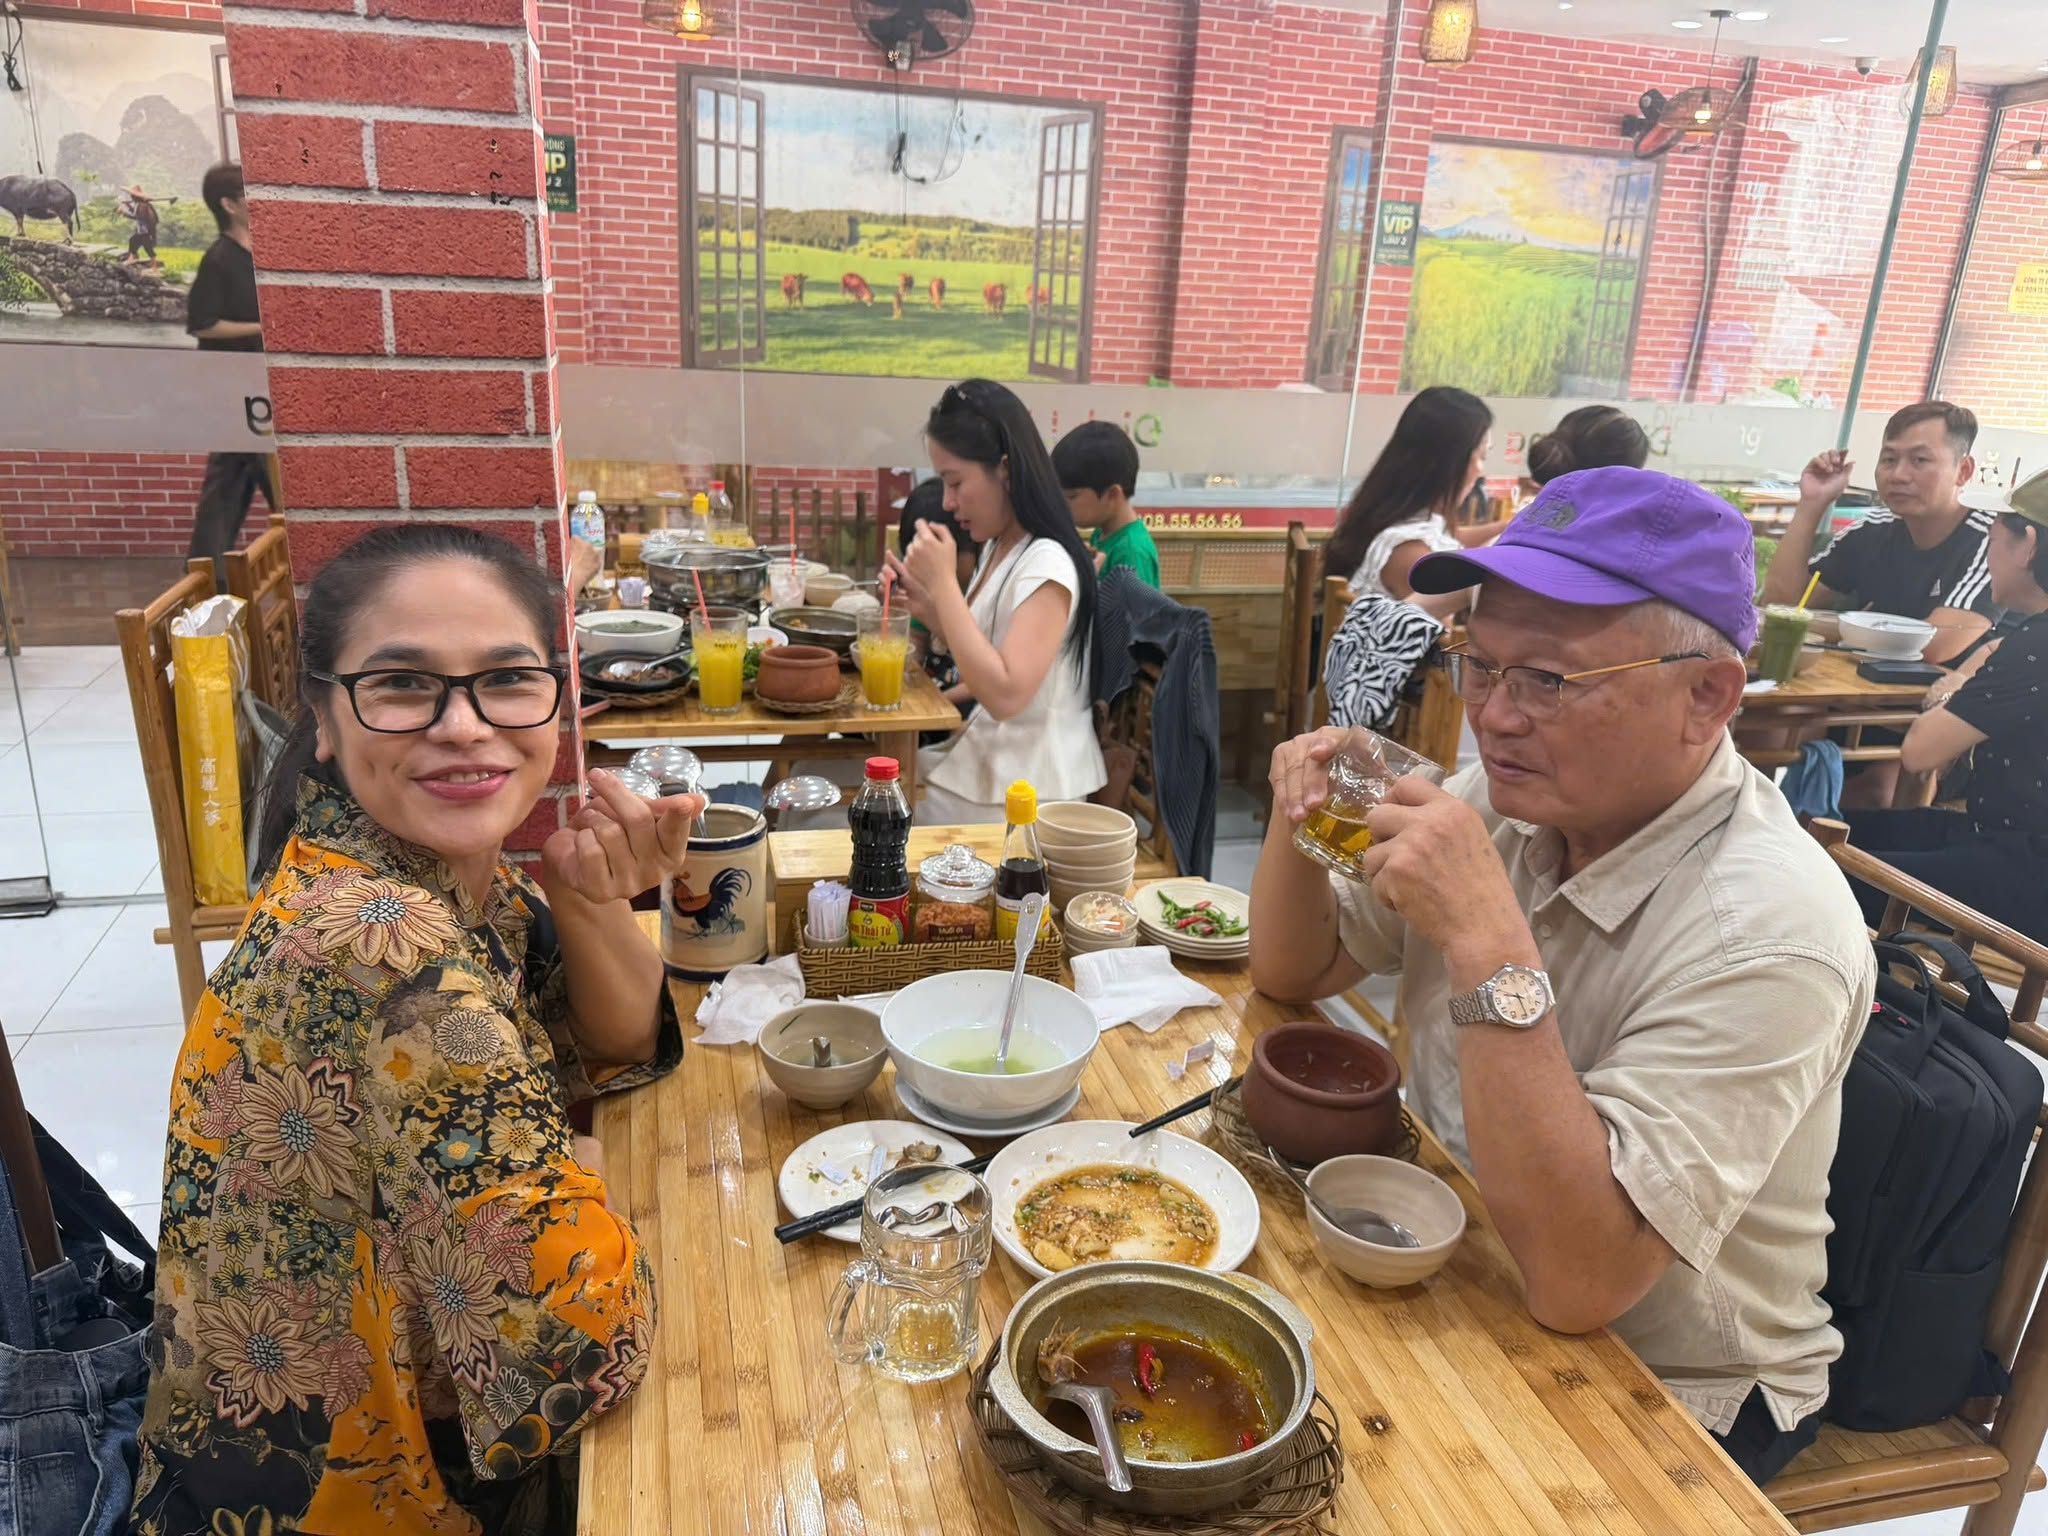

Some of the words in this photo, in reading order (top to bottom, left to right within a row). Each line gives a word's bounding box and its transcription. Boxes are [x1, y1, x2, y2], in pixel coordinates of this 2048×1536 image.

[544, 152, 567, 174] IP
[1383, 215, 1413, 234] VIP
[1142, 511, 1242, 529] 08.55.56.56
